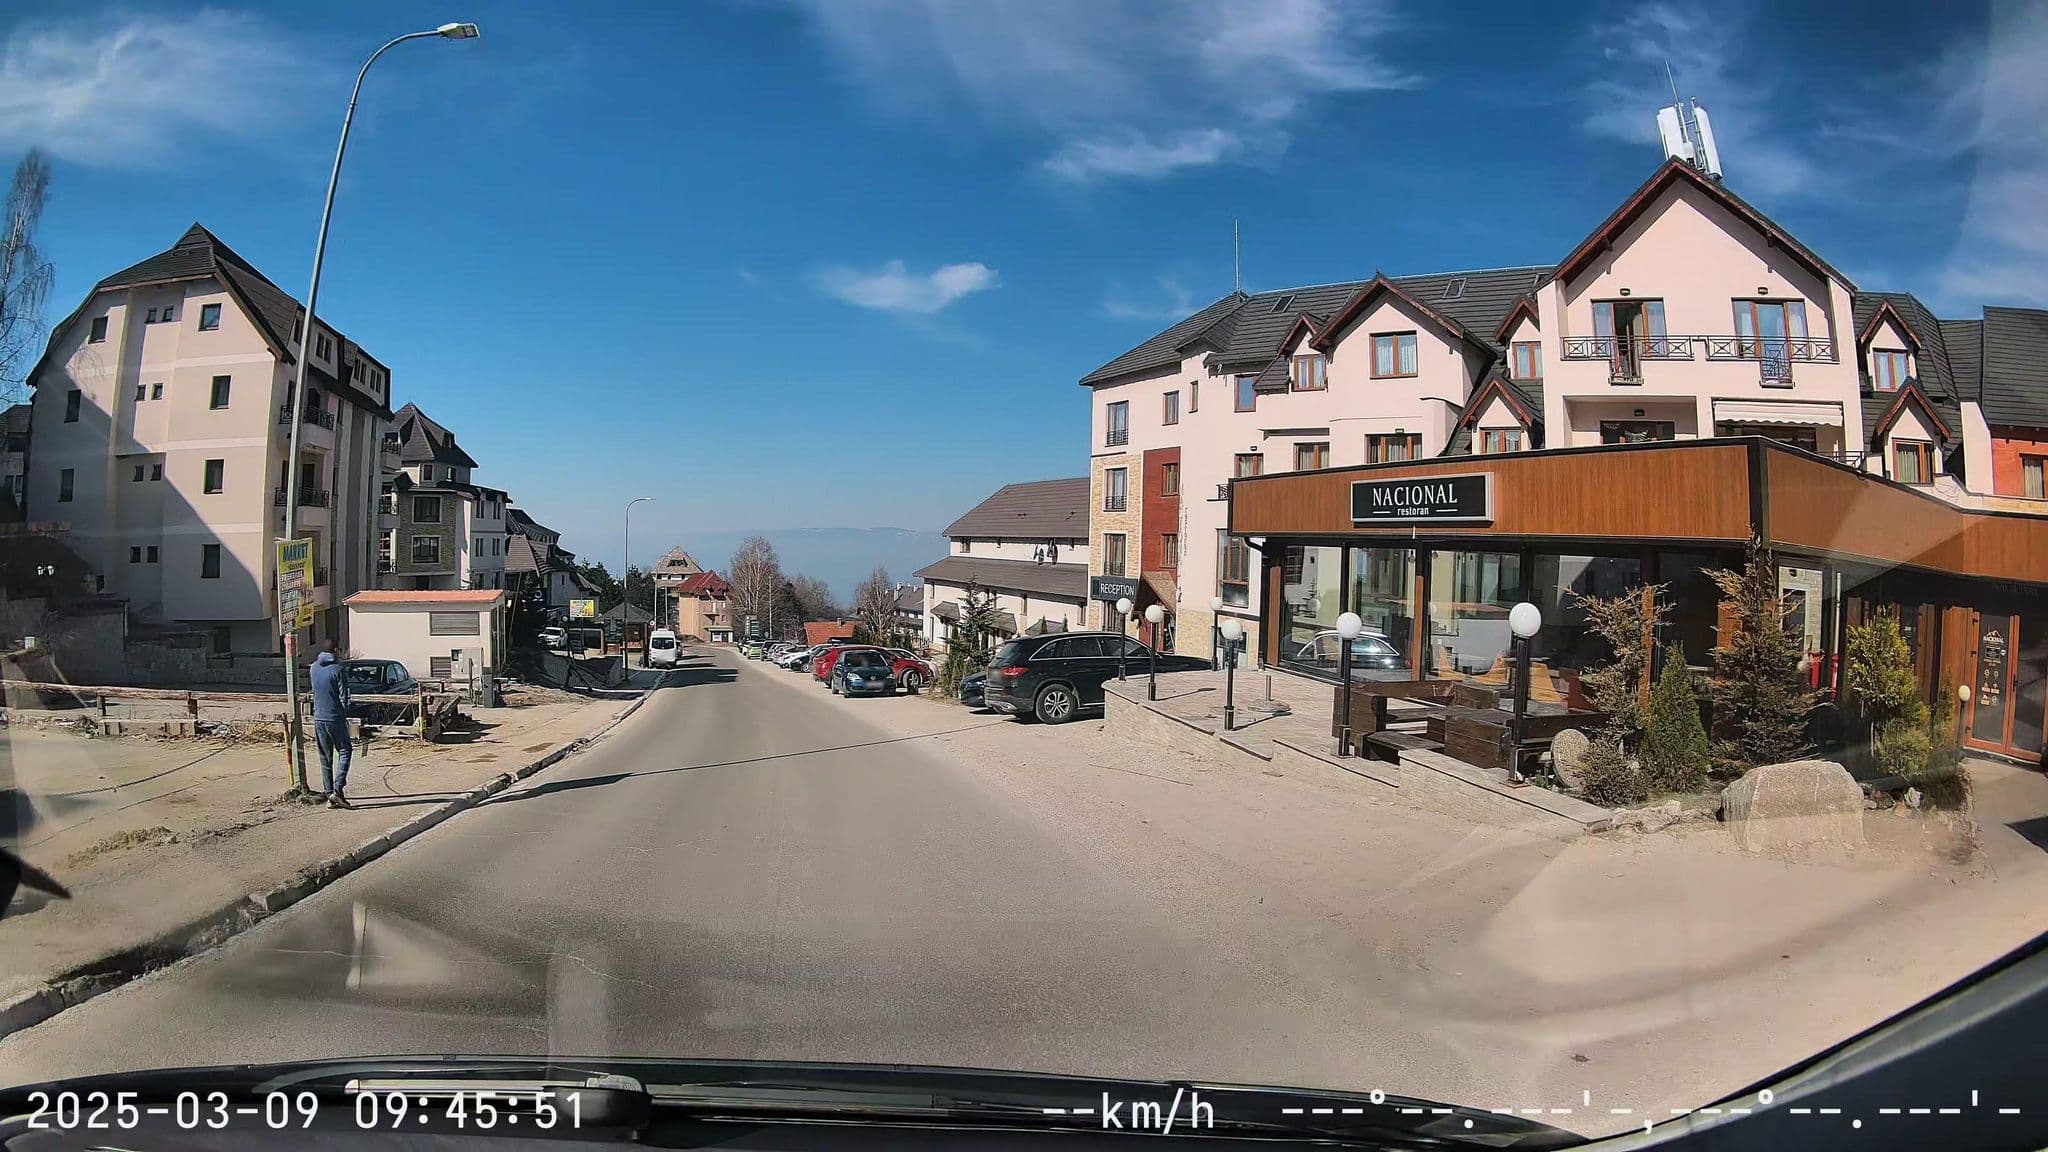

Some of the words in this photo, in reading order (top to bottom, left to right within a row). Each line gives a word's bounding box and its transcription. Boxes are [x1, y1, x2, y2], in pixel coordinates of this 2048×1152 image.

[1372, 484, 1458, 506] NACIONAL
[1397, 507, 1430, 516] restoran
[283, 543, 308, 561] MARKET
[1100, 583, 1134, 596] RECEPTION
